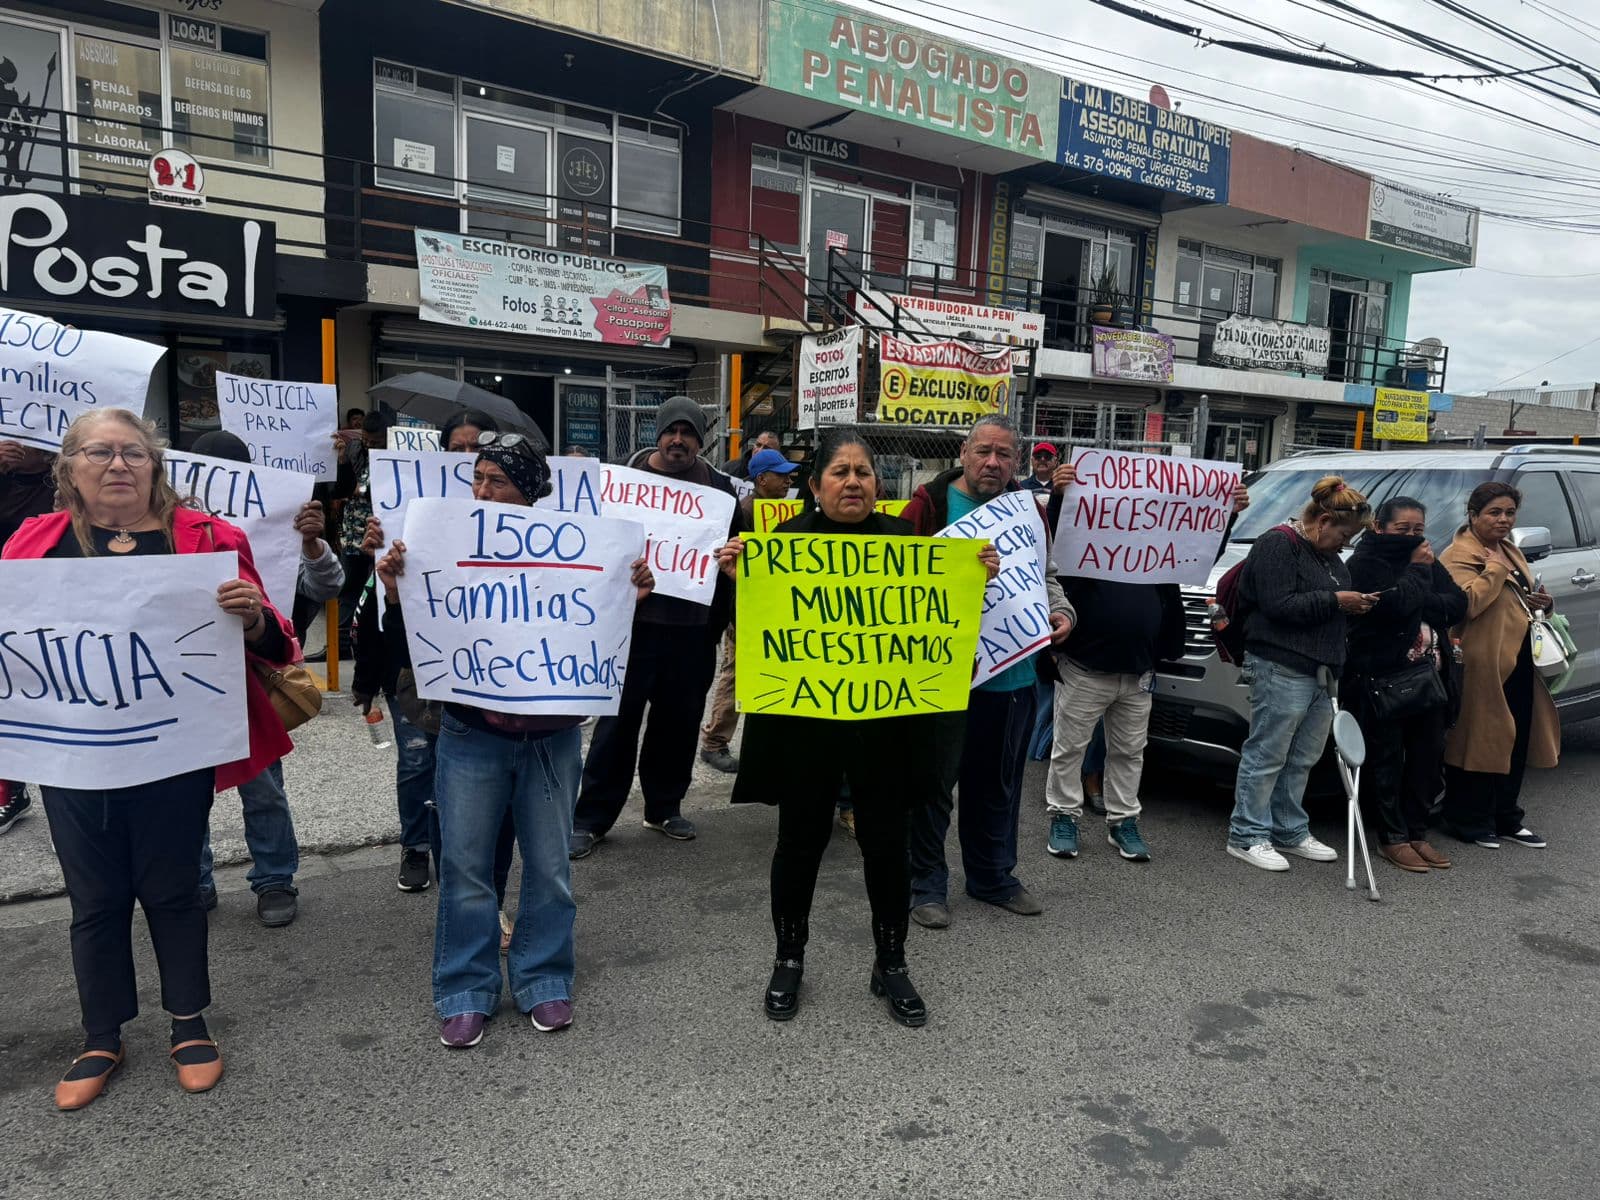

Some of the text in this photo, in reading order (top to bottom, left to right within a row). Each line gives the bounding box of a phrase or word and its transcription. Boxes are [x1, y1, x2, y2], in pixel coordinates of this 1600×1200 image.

[830, 15, 1029, 102] ABOGADO
[93, 80, 133, 96] PENAL
[185, 77, 252, 100] DEFENSA DE LOS
[803, 48, 1046, 150] PENALISTA
[93, 98, 152, 117] AMPAROS
[174, 101, 264, 127] DERECHOS HUMANOS
[1060, 78, 1232, 148] LIC. MA. ISABEL IBARRA TOPETE
[95, 133, 152, 151] LABORAL
[786, 131, 848, 160] CASILLAS
[1079, 109, 1211, 162] ASESORIA GRATUITA
[1082, 130, 1208, 174] ASUNTOS PENALES FEDERALES
[0, 192, 261, 317] Postal
[462, 239, 559, 264] ESCRITORIO
[563, 255, 627, 274] PUBLICO
[511, 262, 533, 274] COPIAS
[432, 268, 480, 282] OFICIALES:
[508, 274, 524, 285] CURP
[528, 277, 539, 287] RFC
[502, 295, 537, 314] Fotos
[977, 308, 990, 318] LA
[992, 309, 1015, 322] PENI
[0, 313, 83, 357] 1500
[558, 326, 572, 336] 7am
[1285, 334, 1328, 353] OFICIALES
[815, 348, 845, 365] FOTOS
[2, 362, 97, 405] milias
[803, 383, 857, 399] TRAUCCIONES
[810, 366, 850, 384] ESCRITOS
[225, 377, 318, 411] JUSTICIA
[568, 392, 598, 408] COPIAS
[245, 412, 292, 432] PARA
[261, 445, 328, 475] Familias
[1074, 450, 1242, 506] GOBERNADORA
[1074, 493, 1227, 533] NECESITAMOS
[469, 508, 587, 562] 1500
[743, 536, 946, 577] PRESIDENTE
[421, 569, 596, 626] Familias
[791, 584, 961, 629] MUNICIPAL,
[452, 637, 618, 689] afectadas
[762, 628, 954, 666] NECESITAMOS
[790, 676, 917, 714] AYUDA
